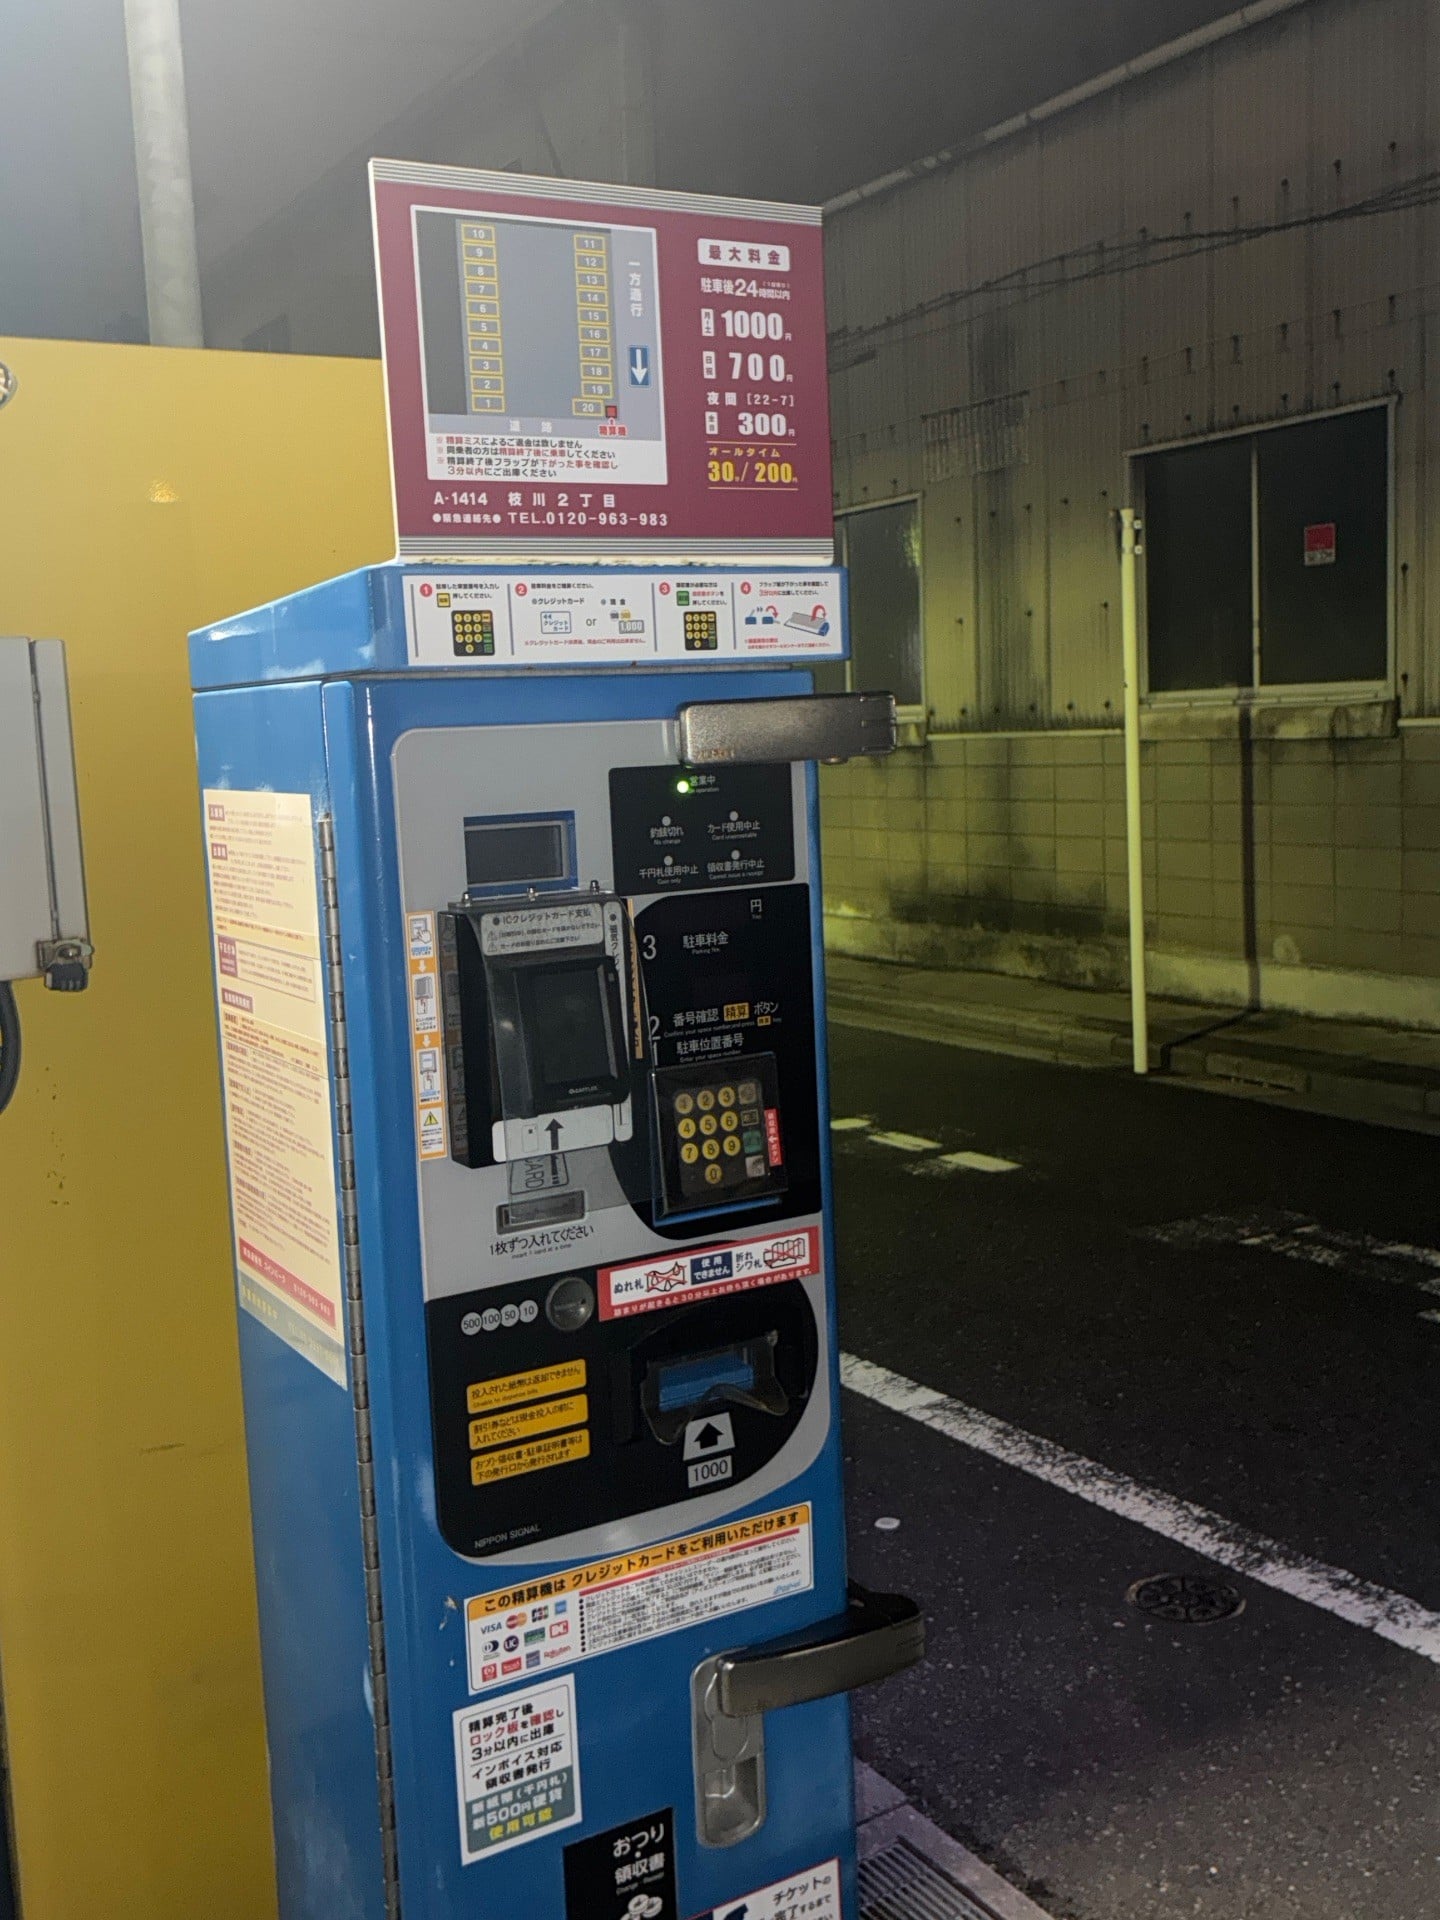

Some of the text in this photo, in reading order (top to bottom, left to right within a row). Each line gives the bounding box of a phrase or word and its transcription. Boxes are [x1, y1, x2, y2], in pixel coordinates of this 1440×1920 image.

[472, 230, 484, 239] 10
[583, 240, 595, 249] 11
[476, 248, 483, 257] 9
[708, 244, 781, 265] 最大料金
[585, 258, 597, 267] 12
[477, 267, 484, 276] 8
[586, 276, 598, 285] 13
[479, 285, 485, 294] 7
[628, 260, 643, 318] 一方通行
[587, 294, 598, 302] 14
[479, 304, 486, 313] 6
[588, 312, 599, 320] 15
[481, 323, 487, 332] 5
[589, 330, 600, 339] 16
[482, 342, 488, 351] 4
[590, 348, 601, 357] 17
[483, 361, 489, 370] 3
[590, 367, 602, 376] 18
[484, 380, 491, 389] 2
[591, 385, 603, 394] 19
[486, 400, 491, 408] 1
[706, 391, 738, 406] 夜間
[582, 403, 594, 412] 20
[708, 446, 781, 457] オールタイム
[586, 618, 598, 627] or
[750, 899, 763, 913] 円
[682, 931, 729, 949] 駐車料金
[642, 934, 657, 960] 3
[672, 1008, 720, 1028] 番号確認
[754, 1001, 779, 1015] ボタン
[649, 1015, 661, 1041] 2
[676, 1033, 745, 1056] 駐車位置番号
[490, 1225, 594, 1256] 1枚ずつ入れてください
[701, 1255, 723, 1268] 使用
[693, 1265, 731, 1281] できません
[614, 1281, 644, 1294] ぬれ札
[463, 1305, 534, 1330] 500 100 50 10
[693, 1459, 729, 1482] 1000
[474, 1524, 540, 1549] NIPPON SIGNAL
[481, 1621, 503, 1635] VISA
[468, 1703, 534, 1733] 精算完了後
[472, 1723, 555, 1762] 3分以内に出庫
[472, 1740, 563, 1780] インボイス対応
[486, 1759, 551, 1790] 領収書発行
[614, 1852, 665, 1885] 領収書
[772, 1875, 832, 1906] チケットの
